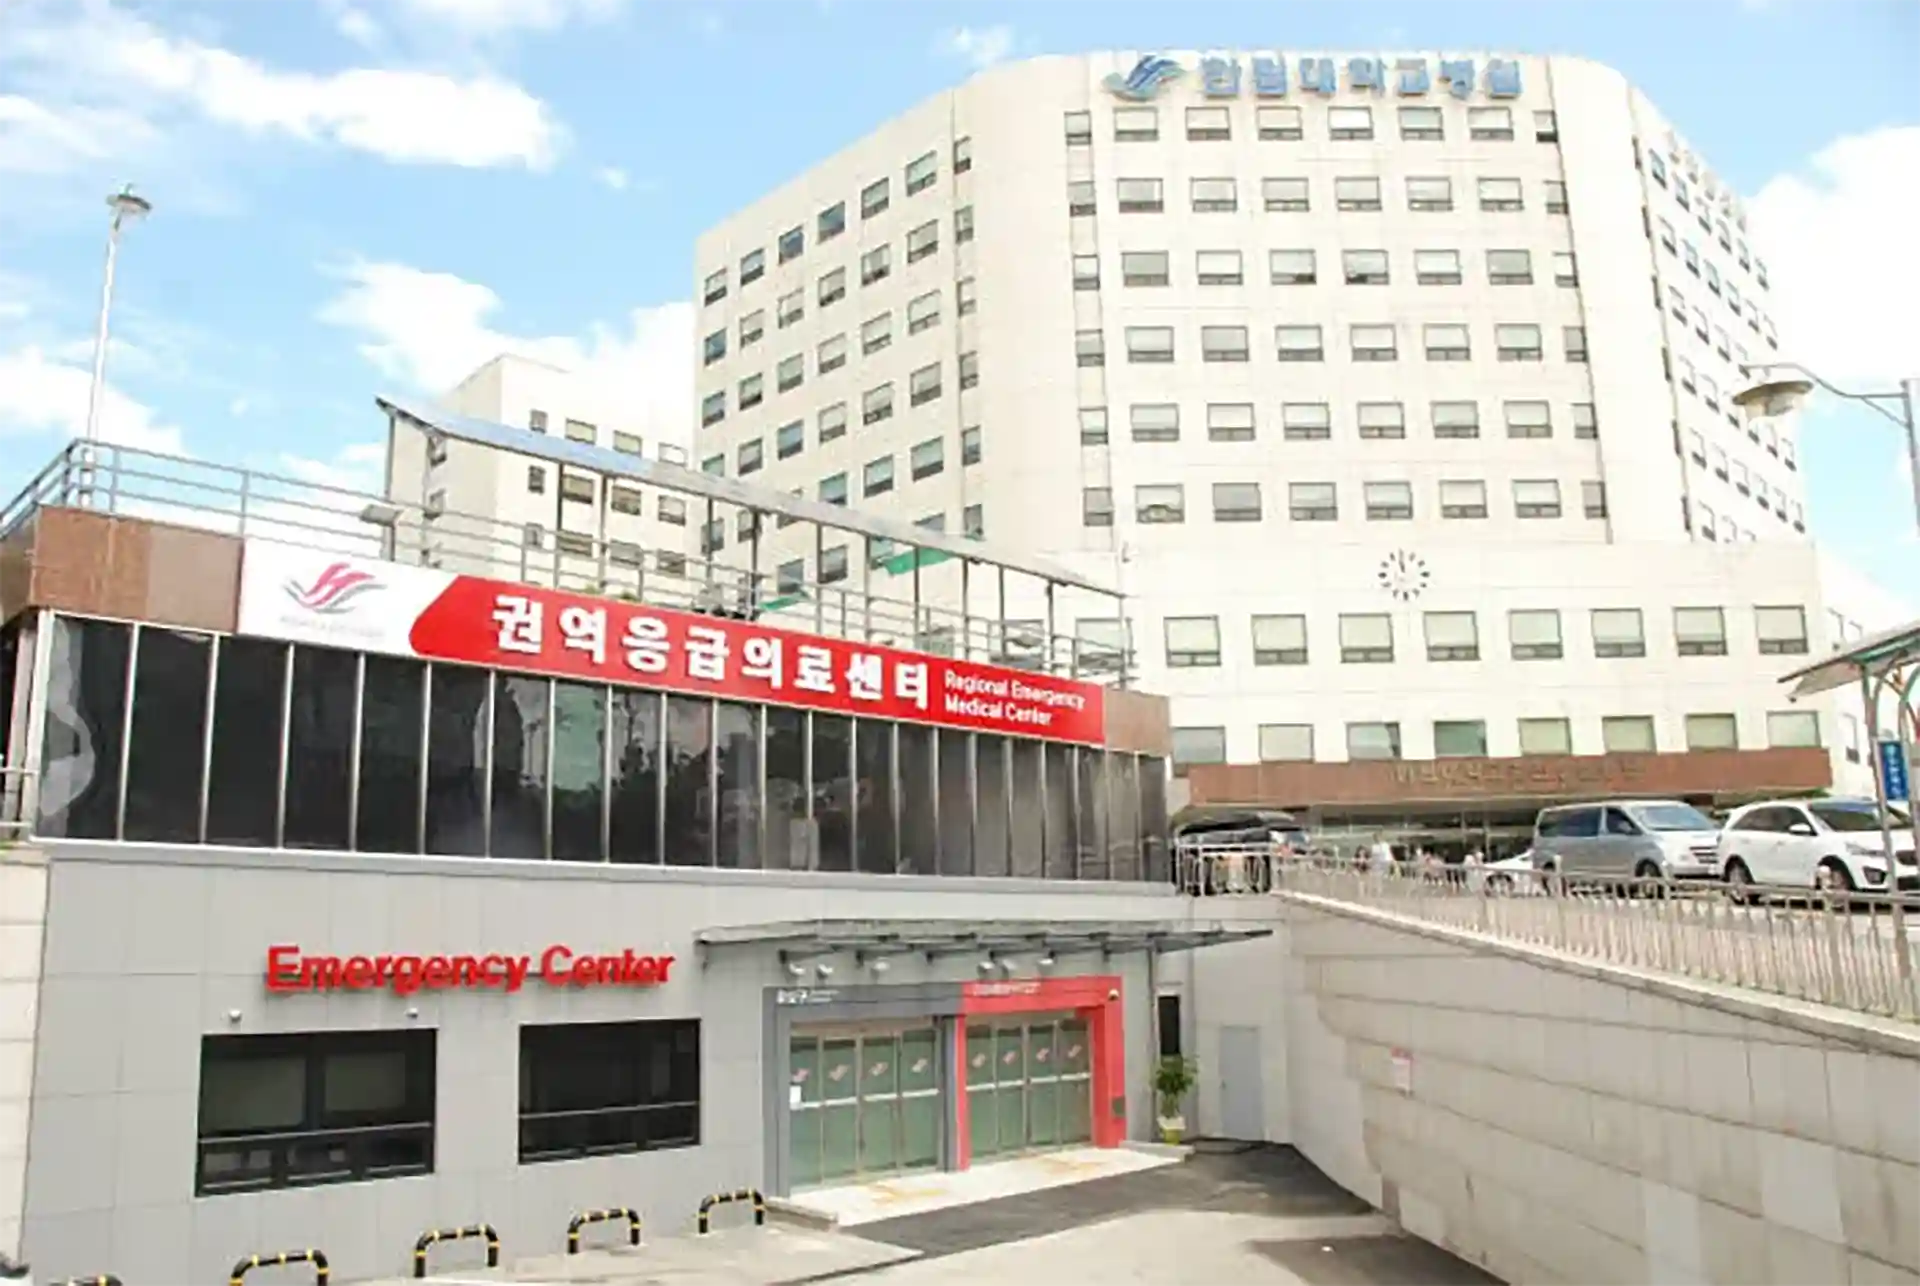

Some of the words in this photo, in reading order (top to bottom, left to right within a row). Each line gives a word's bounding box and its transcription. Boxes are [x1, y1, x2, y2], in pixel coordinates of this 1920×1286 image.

[493, 594, 929, 710] 권역응급의료센터
[945, 669, 1008, 696] Regional
[1011, 680, 1086, 710] Emergency
[945, 694, 1003, 718] Medical
[1005, 702, 1052, 725] Center
[266, 945, 530, 994] Emergency
[541, 944, 675, 987] Center
